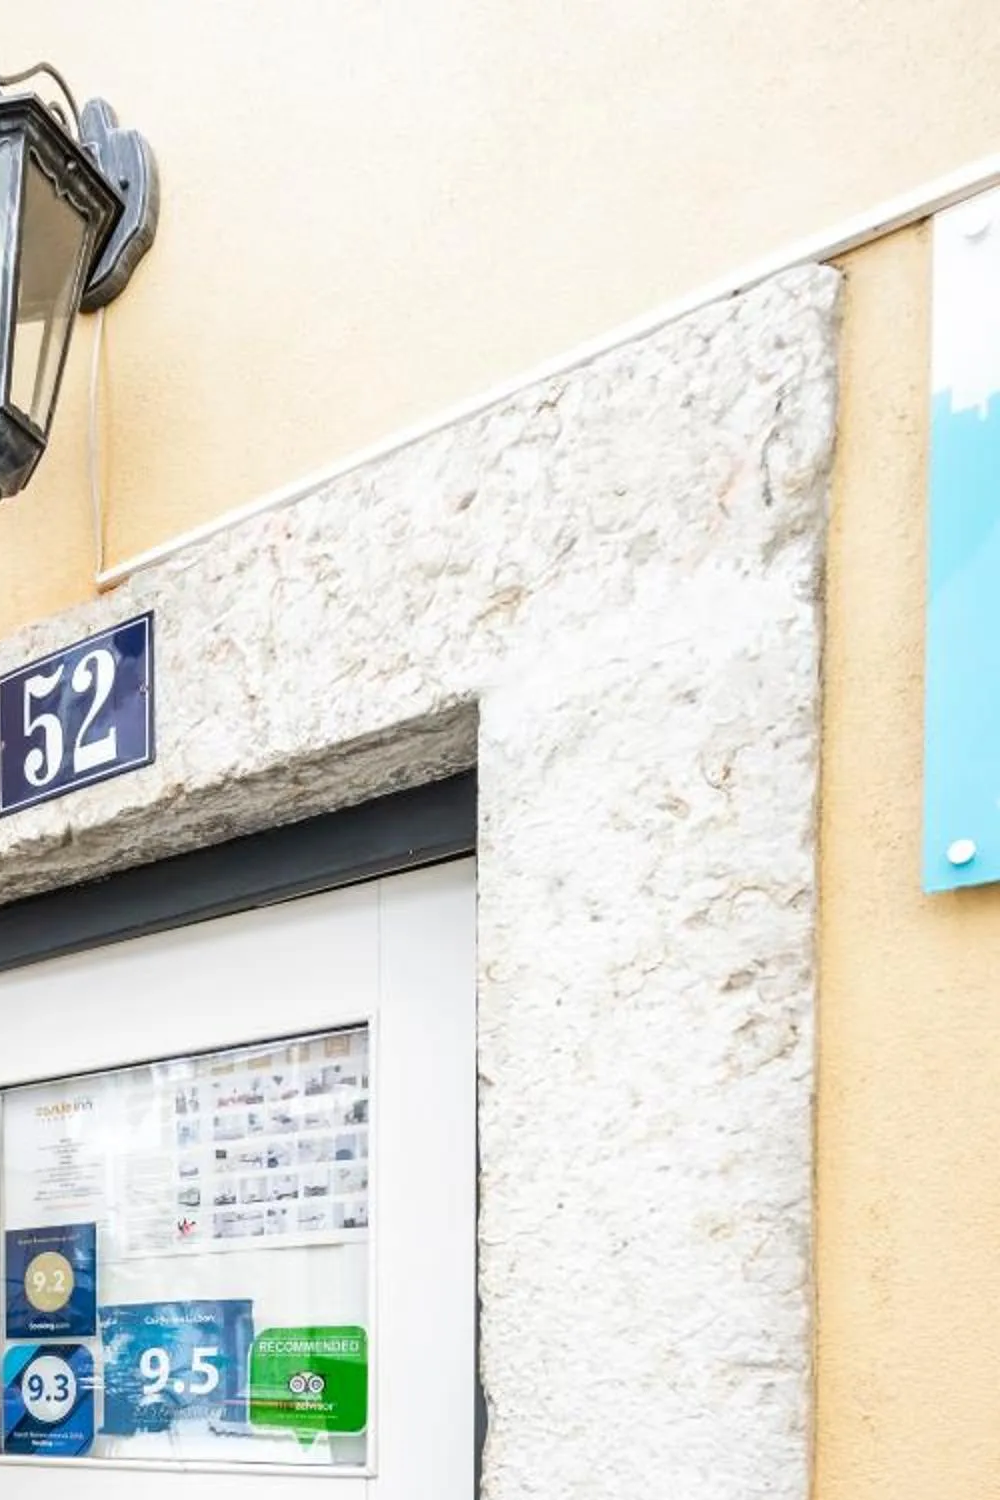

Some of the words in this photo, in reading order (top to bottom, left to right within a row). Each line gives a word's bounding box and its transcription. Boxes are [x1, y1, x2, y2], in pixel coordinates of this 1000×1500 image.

[23, 649, 117, 787] 52
[33, 1269, 66, 1293] 9.2
[259, 1340, 360, 1353] RECOMMENDED
[139, 1346, 220, 1396] 9.5
[27, 1373, 69, 1402] 9.3
